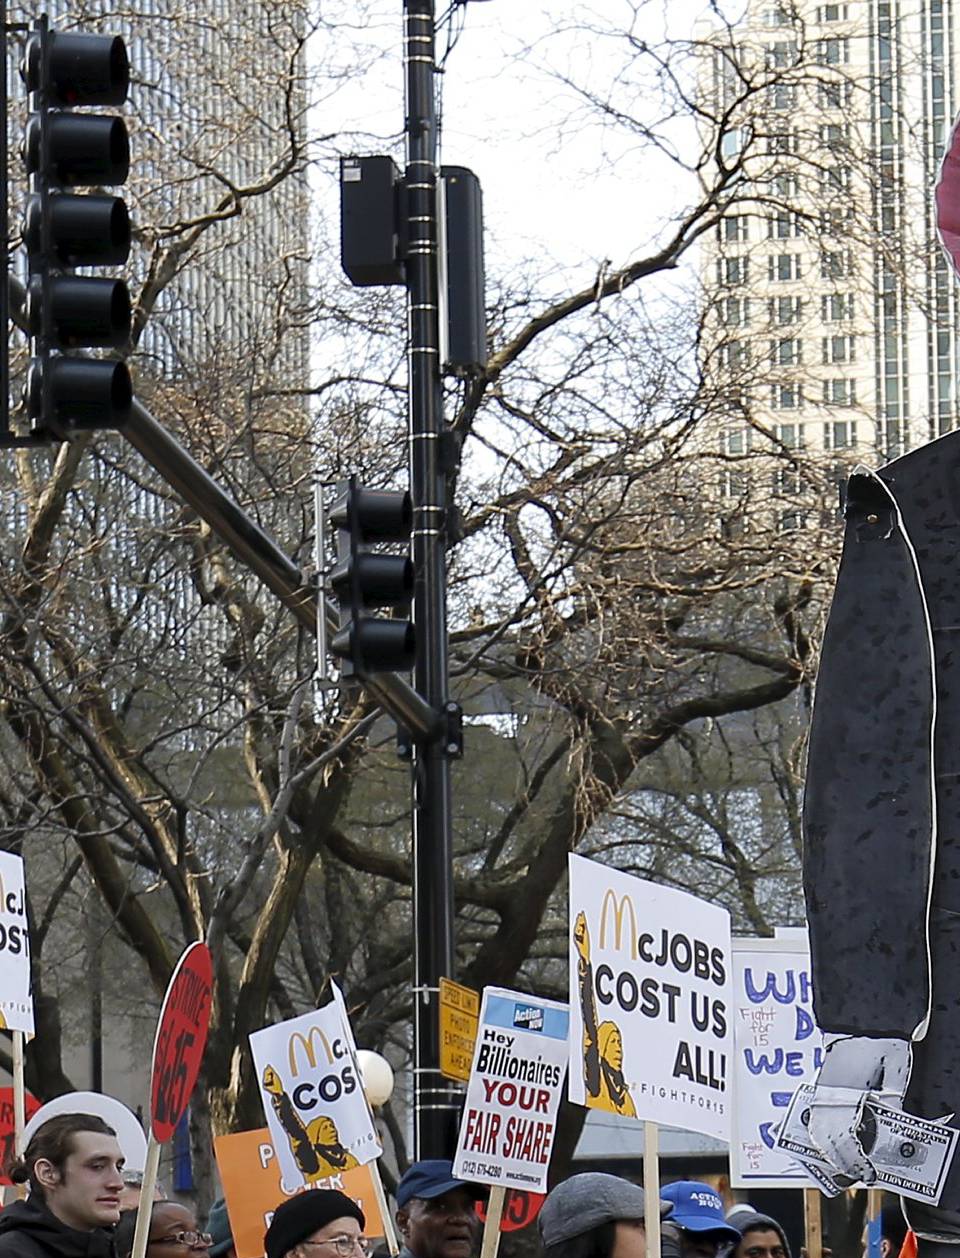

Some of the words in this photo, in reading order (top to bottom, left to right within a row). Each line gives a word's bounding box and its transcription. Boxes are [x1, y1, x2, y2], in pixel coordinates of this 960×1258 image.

[595, 963, 681, 1024] COST
[691, 990, 728, 1039] US
[740, 1007, 776, 1026] Fight
[484, 1029, 515, 1048] Hey
[753, 1032, 769, 1047] 15
[476, 1044, 561, 1088] Billionaires
[672, 1041, 727, 1093] ALL!
[744, 1048, 804, 1077] WE
[483, 1079, 552, 1115] YOUR
[463, 1109, 502, 1156] FAIR
[503, 1116, 553, 1165] SHARE
